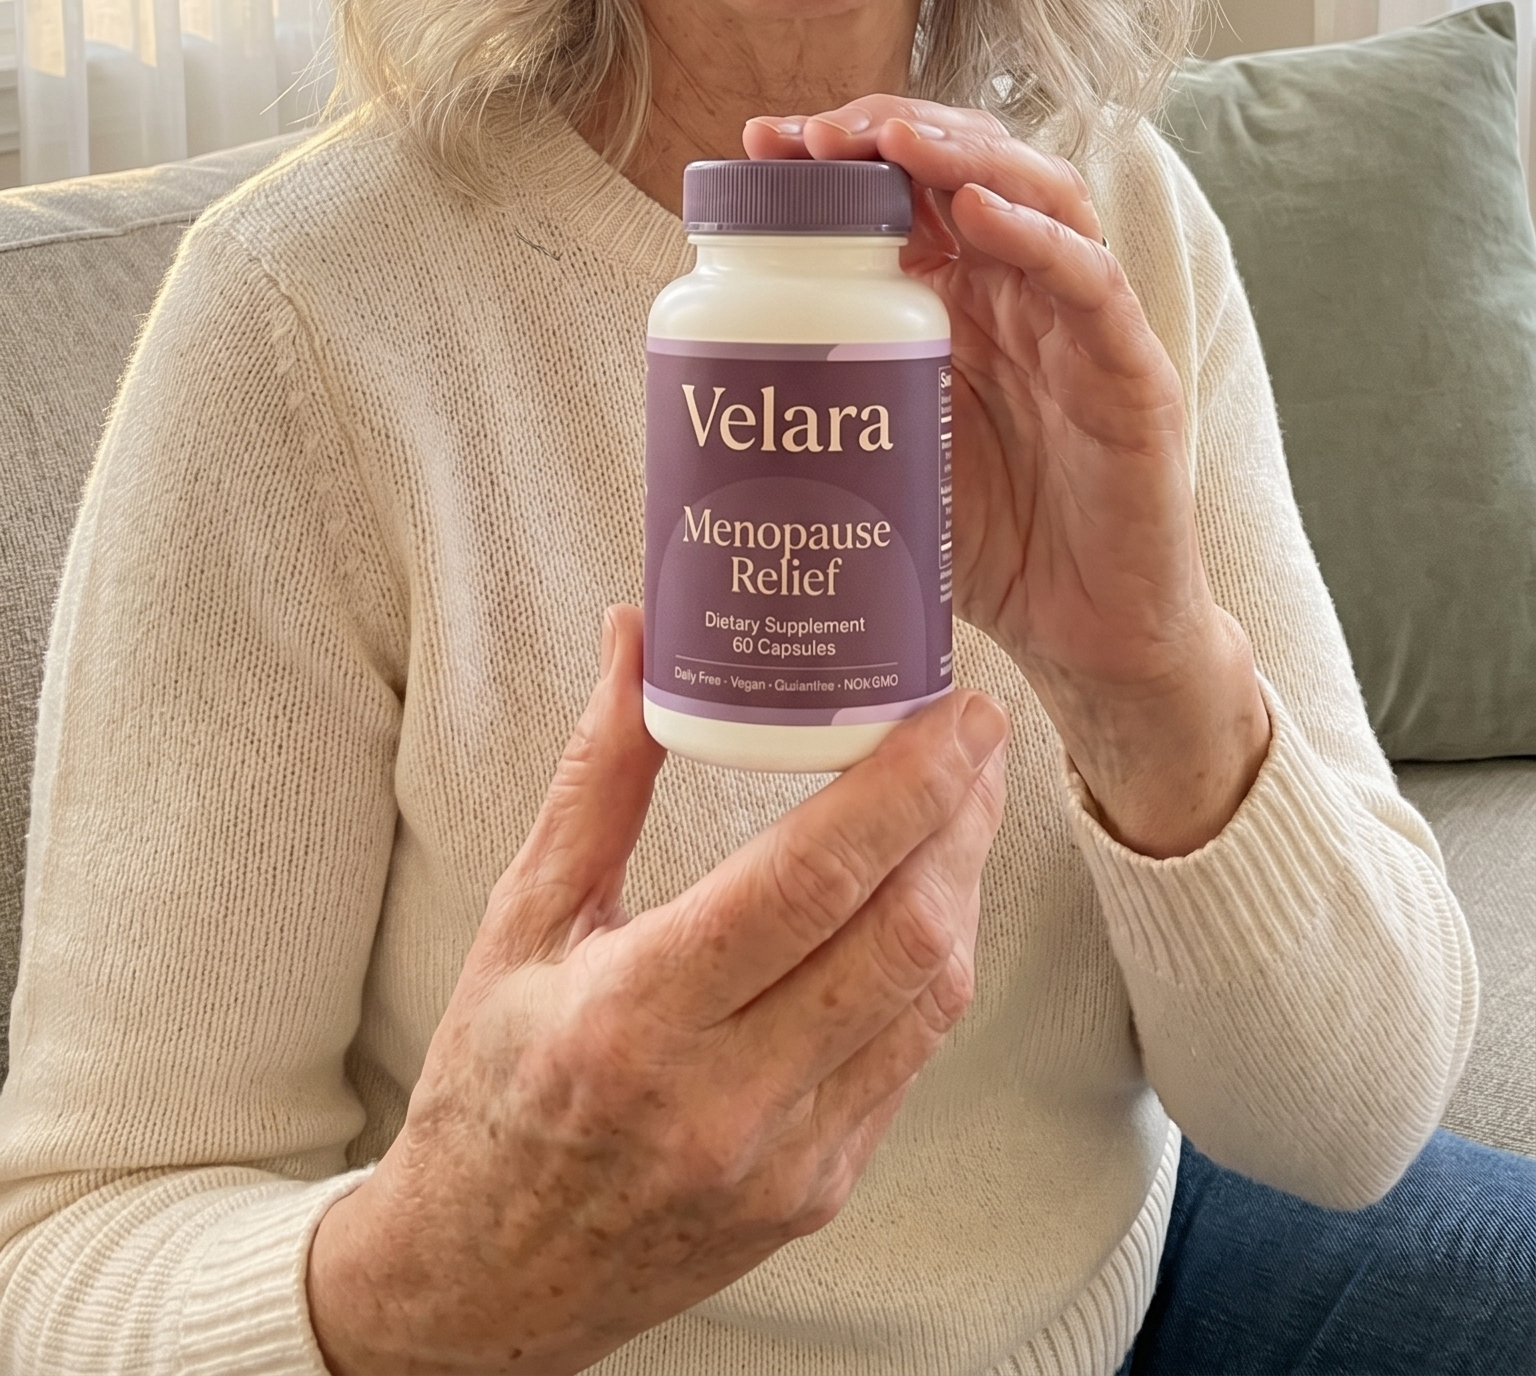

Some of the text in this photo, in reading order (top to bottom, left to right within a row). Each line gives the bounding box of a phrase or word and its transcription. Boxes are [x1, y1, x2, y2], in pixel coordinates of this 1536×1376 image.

[681, 384, 894, 453] Velara
[683, 505, 891, 560] Menopause
[731, 556, 843, 596] Relief
[705, 611, 866, 637] Dietary Supplement
[732, 636, 837, 659] 60 Capsules
[730, 675, 766, 693] Vegan
